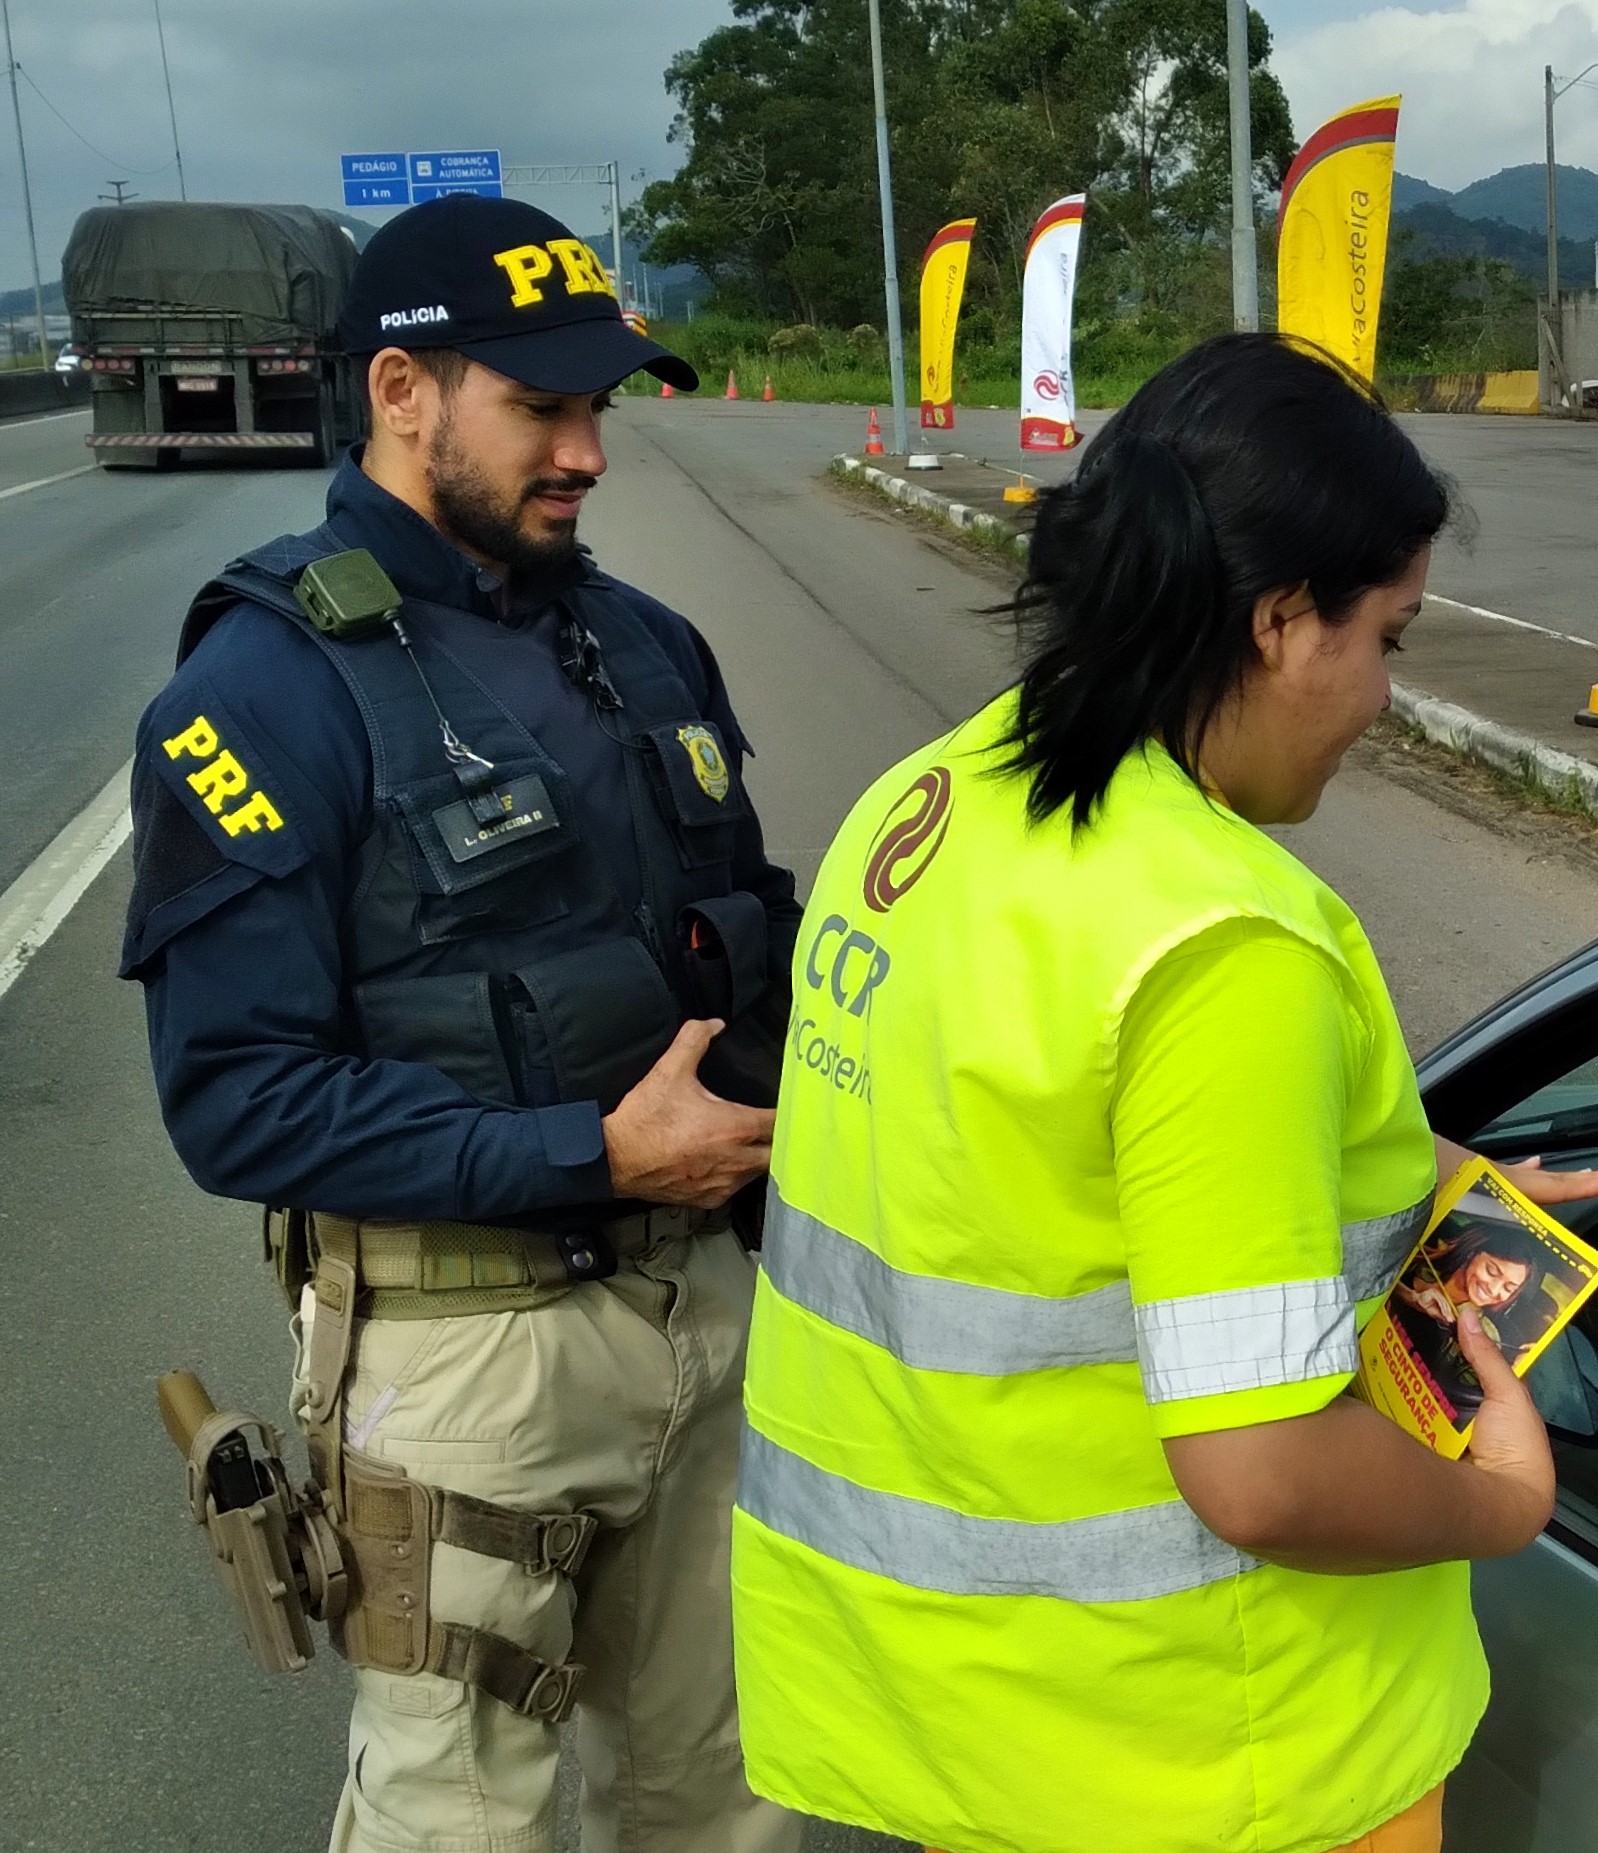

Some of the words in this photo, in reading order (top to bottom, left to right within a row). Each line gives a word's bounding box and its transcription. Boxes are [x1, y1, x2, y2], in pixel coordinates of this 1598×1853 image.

[352, 160, 397, 173] PEDÁGIO
[439, 167, 494, 178] AUTOMÁTICA
[440, 156, 489, 168] COBRANÇA
[361, 188, 367, 198] 1
[372, 188, 391, 198] km
[162, 715, 284, 837] PRF
[478, 814, 533, 841] OLIVEIRA
[806, 914, 891, 1026] CCR
[1498, 1189, 1513, 1205] COM
[1385, 1326, 1394, 1342] O
[1392, 1341, 1423, 1395] CINTO
[1420, 1395, 1439, 1421] DE
[1378, 1338, 1438, 1452] SEGURANÇA
